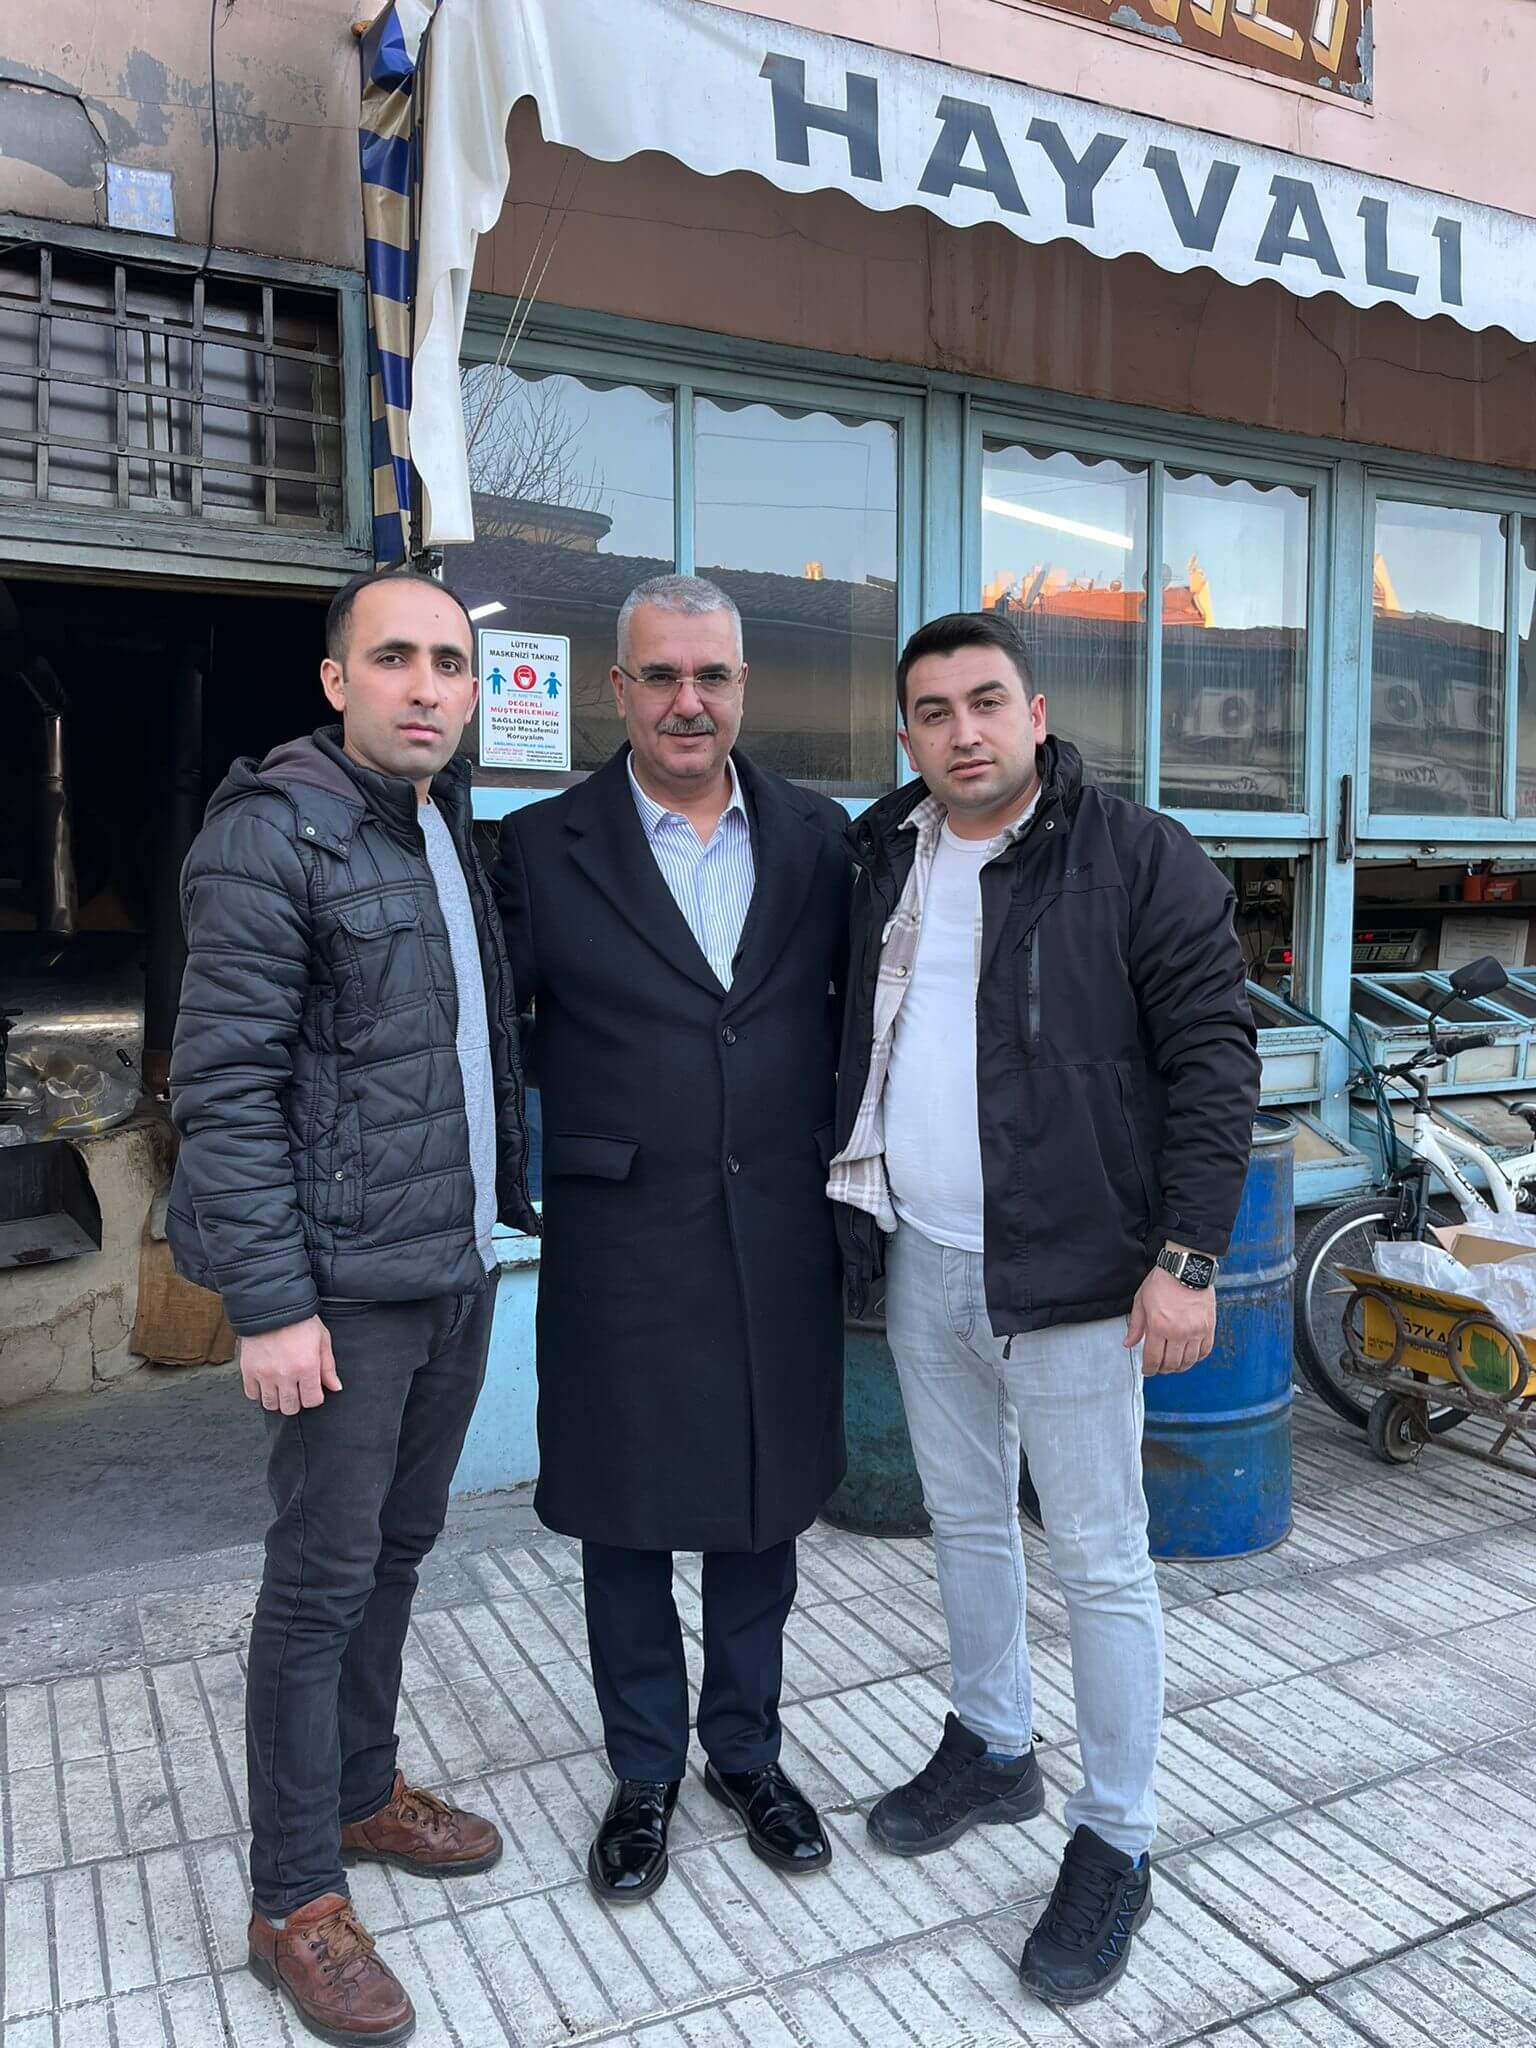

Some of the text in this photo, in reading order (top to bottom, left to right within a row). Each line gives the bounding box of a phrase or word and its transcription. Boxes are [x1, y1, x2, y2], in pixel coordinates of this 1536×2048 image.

[759, 52, 1463, 306] HAYVALI
[511, 640, 539, 650] LÜTFEN
[489, 649, 560, 662] MASKENİZİ TAKINIZ
[508, 699, 543, 708] DEĞERLİ
[491, 717, 559, 727] SAĞLIĞINIZ İÇİN
[491, 723, 517, 732] Sosyal
[507, 733, 545, 741] Koruyalım
